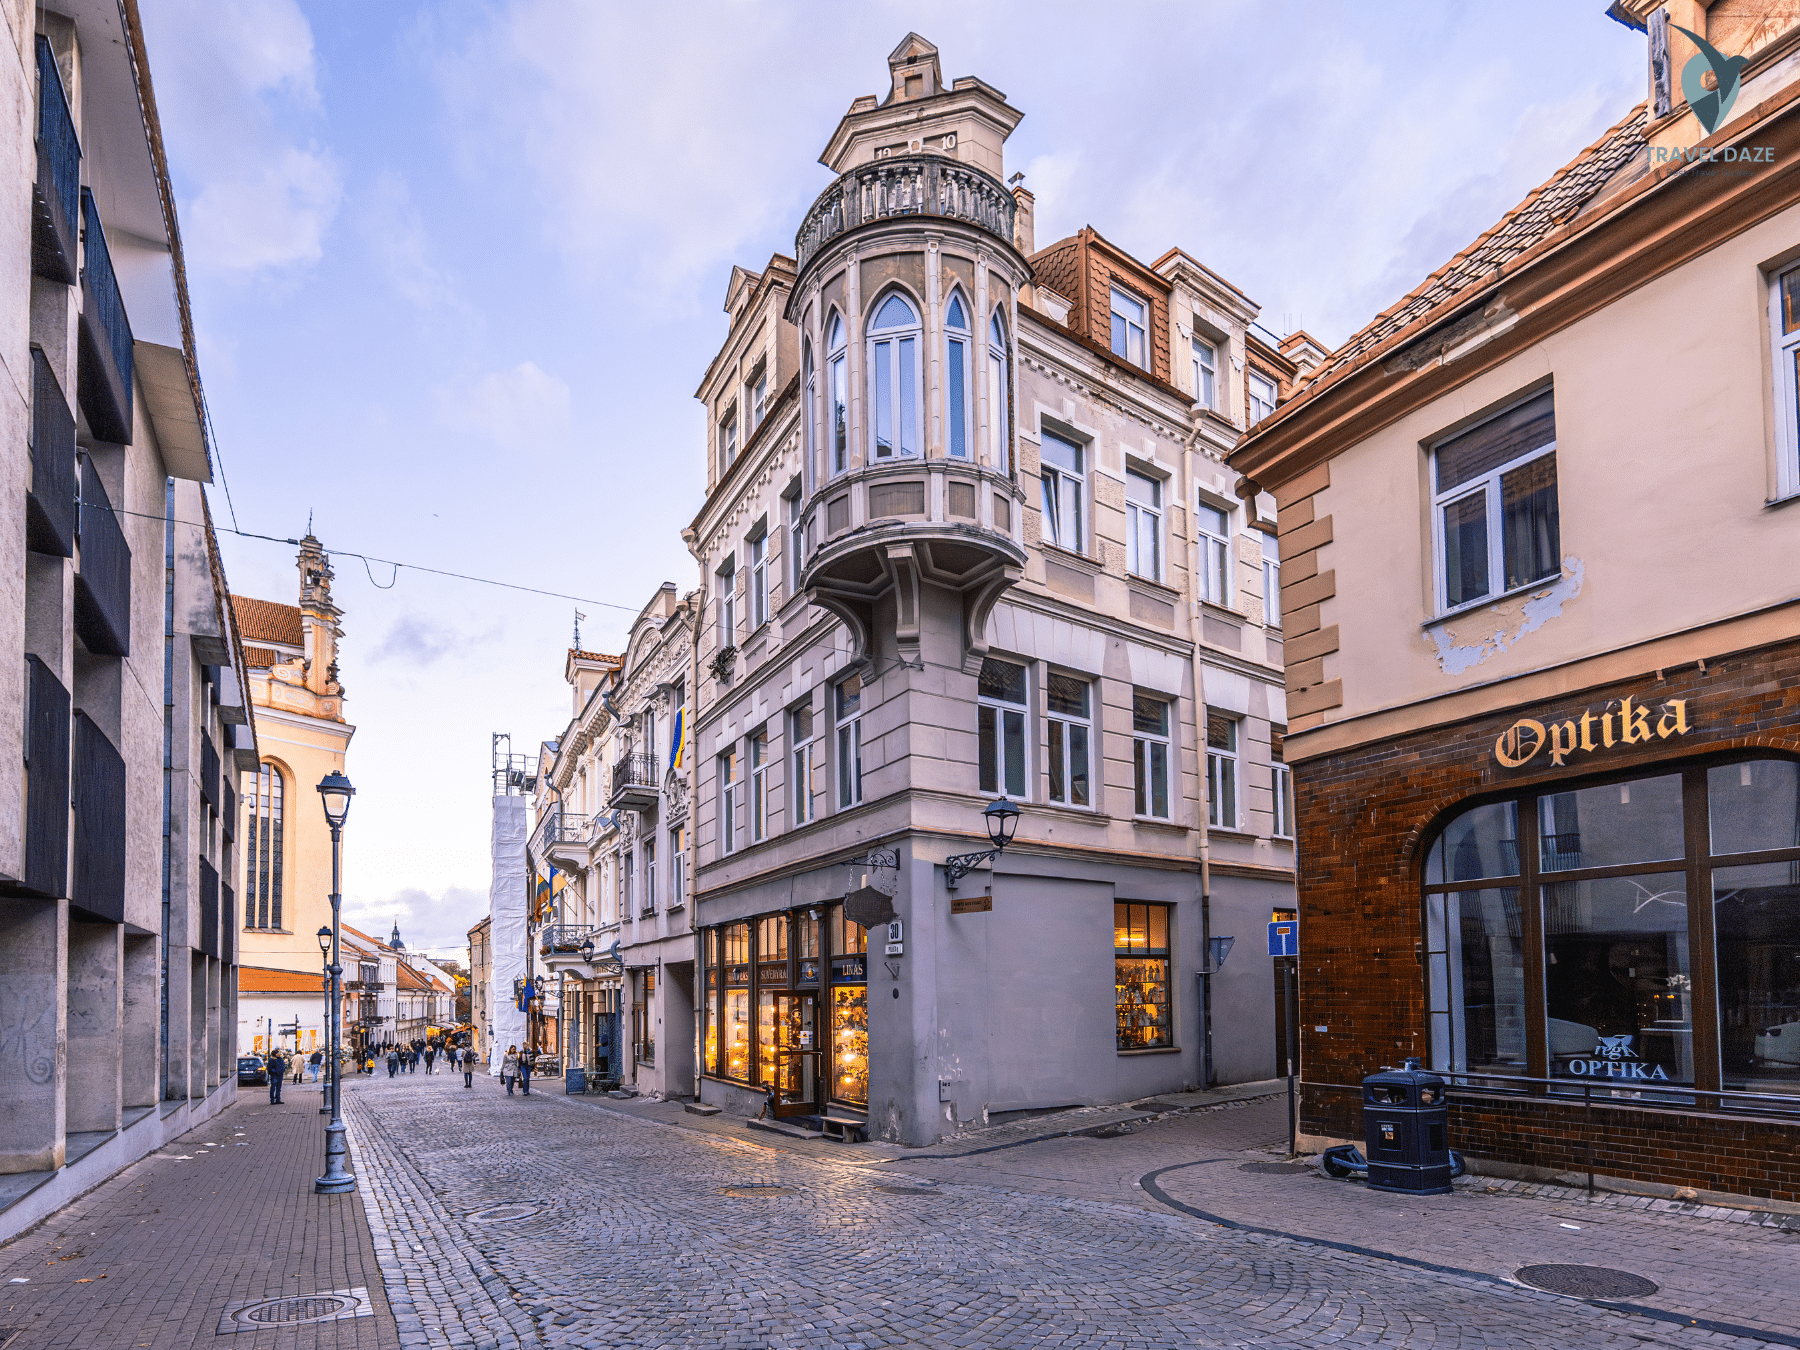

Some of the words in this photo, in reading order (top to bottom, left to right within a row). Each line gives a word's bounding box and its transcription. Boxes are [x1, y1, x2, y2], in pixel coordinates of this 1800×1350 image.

[941, 134, 957, 150] 10
[1495, 694, 1691, 768] Optika
[890, 923, 899, 940] 30
[842, 964, 863, 976] LINAS
[1569, 1059, 1669, 1080] OPTIKA
